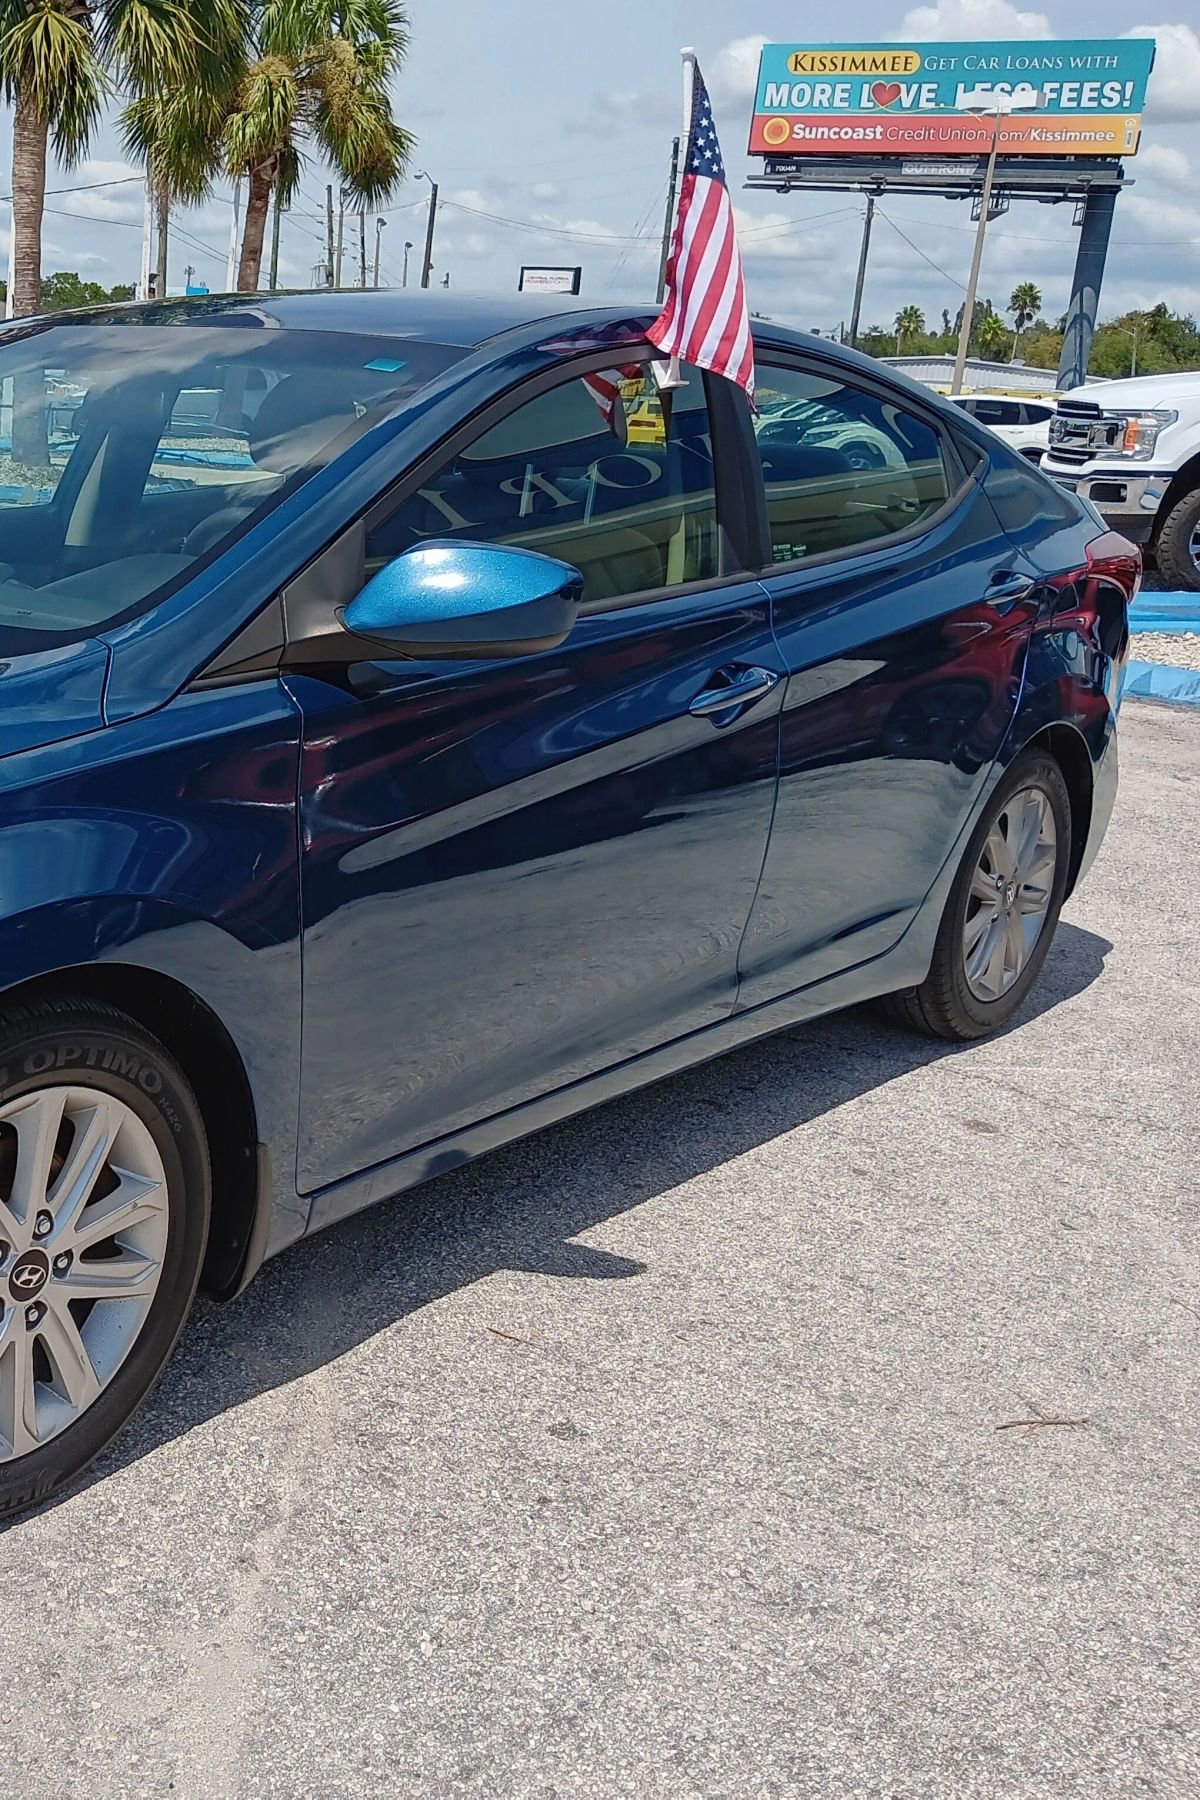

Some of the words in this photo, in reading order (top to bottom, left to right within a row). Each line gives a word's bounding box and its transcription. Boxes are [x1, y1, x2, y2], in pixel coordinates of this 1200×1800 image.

[764, 82, 851, 108] MORE
[1043, 80, 1134, 108] FEES!
[792, 123, 883, 140] Suncoast
[886, 125, 935, 141] Credit
[23, 1045, 163, 1094] OPTIMO
